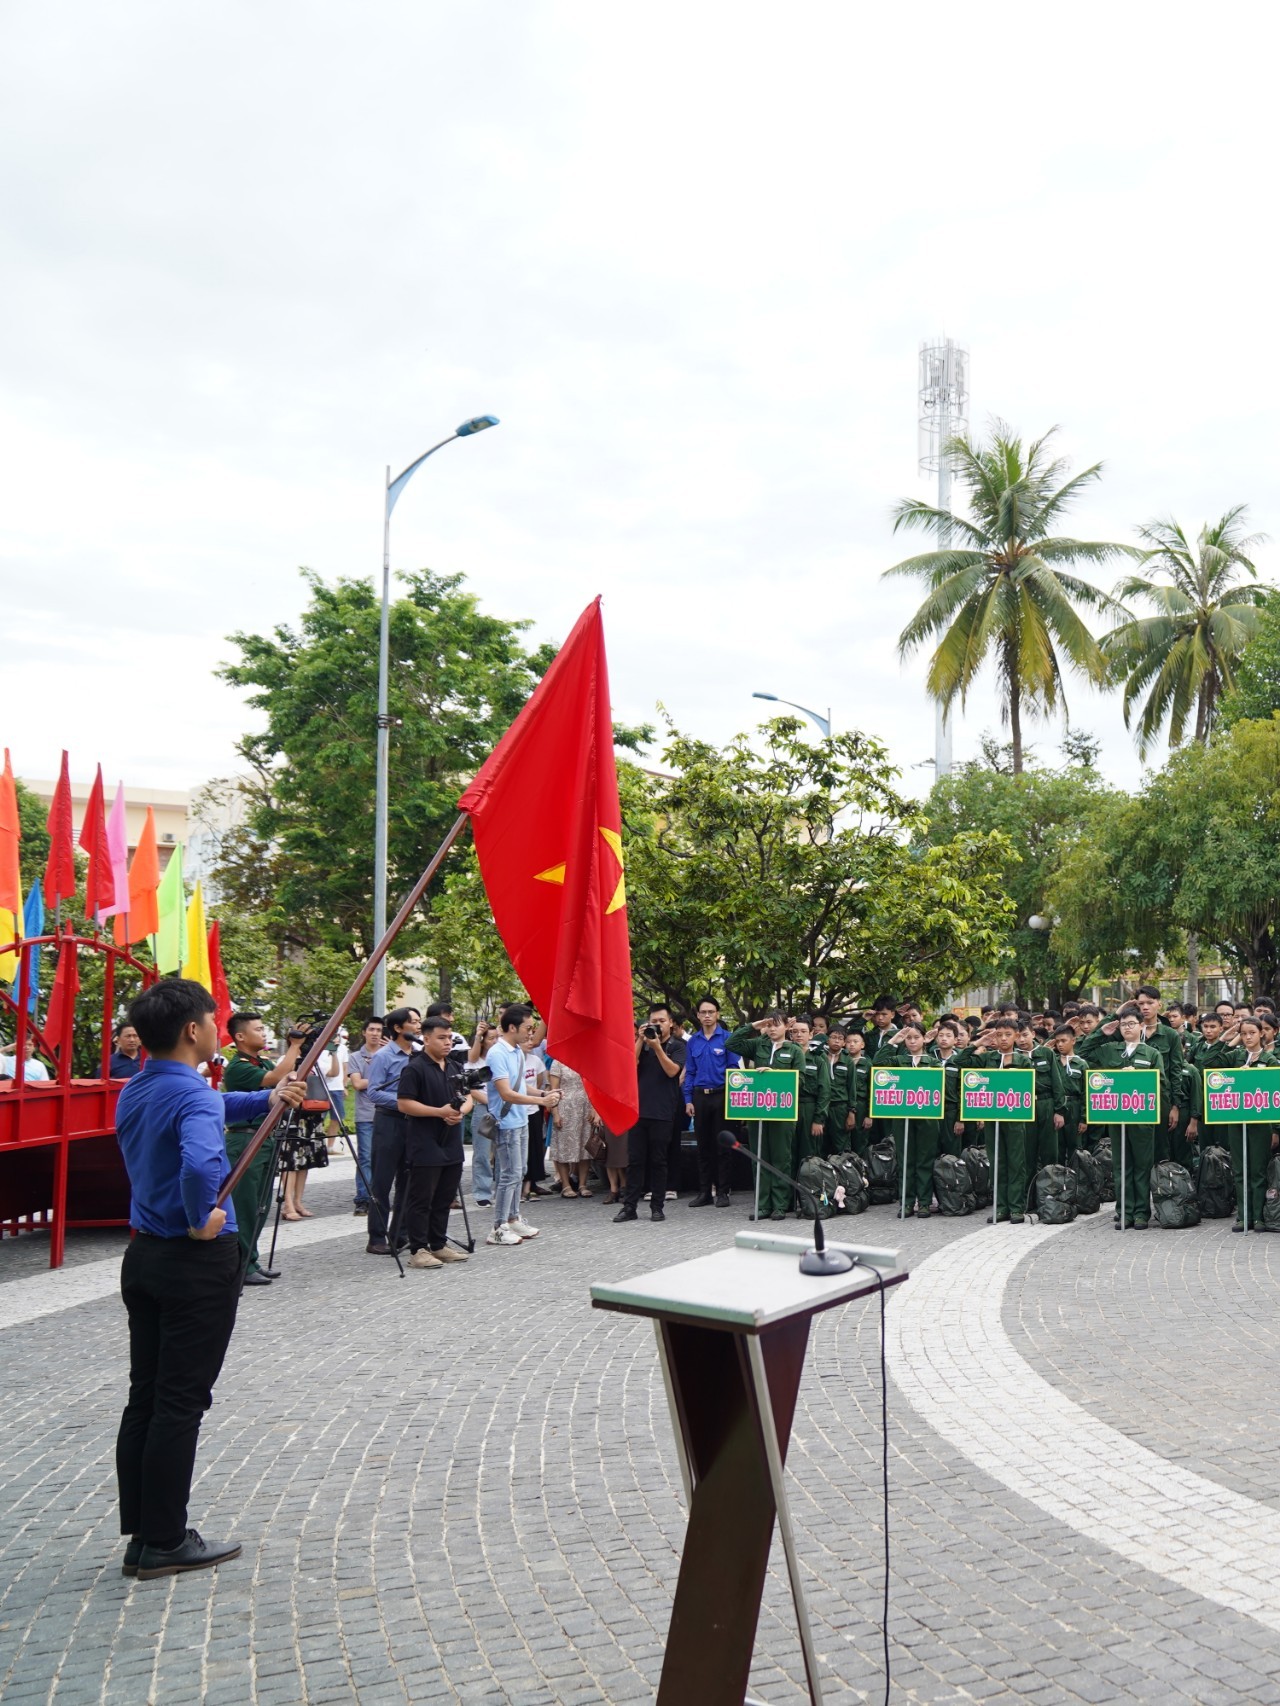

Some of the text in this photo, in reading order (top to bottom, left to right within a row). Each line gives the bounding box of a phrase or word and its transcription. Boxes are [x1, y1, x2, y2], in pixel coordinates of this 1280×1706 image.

[730, 1086, 793, 1111] TIỂU ĐỘI 10
[875, 1084, 941, 1109] TIỂU ĐỘI 9
[965, 1086, 1032, 1111] TIỂU ĐỘI 8
[1090, 1087, 1156, 1114] TIỂU ĐỘI 7
[1209, 1086, 1280, 1112] TIỂU ĐỘI 6
